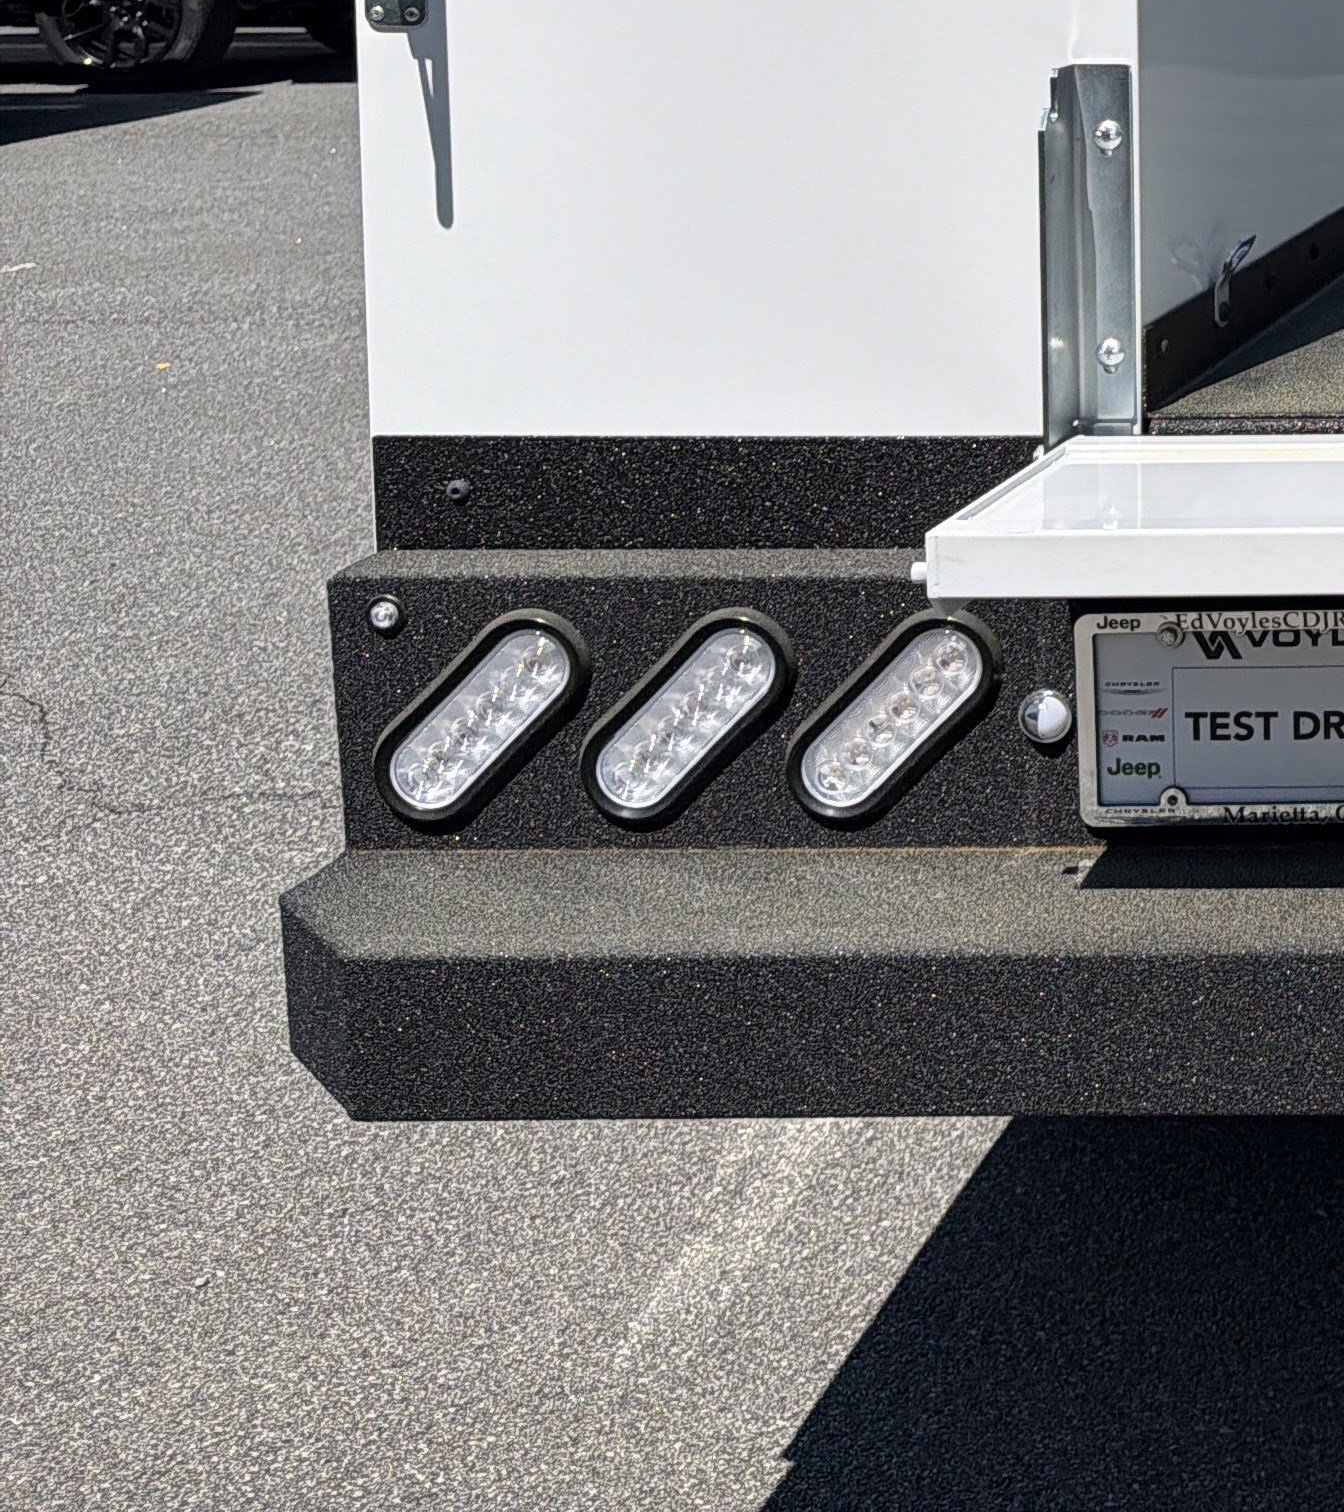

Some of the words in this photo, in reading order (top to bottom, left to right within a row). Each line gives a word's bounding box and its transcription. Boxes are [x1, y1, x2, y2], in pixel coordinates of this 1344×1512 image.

[1096, 615, 1141, 631] Jeep
[1185, 710, 1279, 741] TEST
[1122, 733, 1166, 742] RAM
[1106, 757, 1162, 779] Jeep
[1222, 804, 1332, 825] Marietta,
